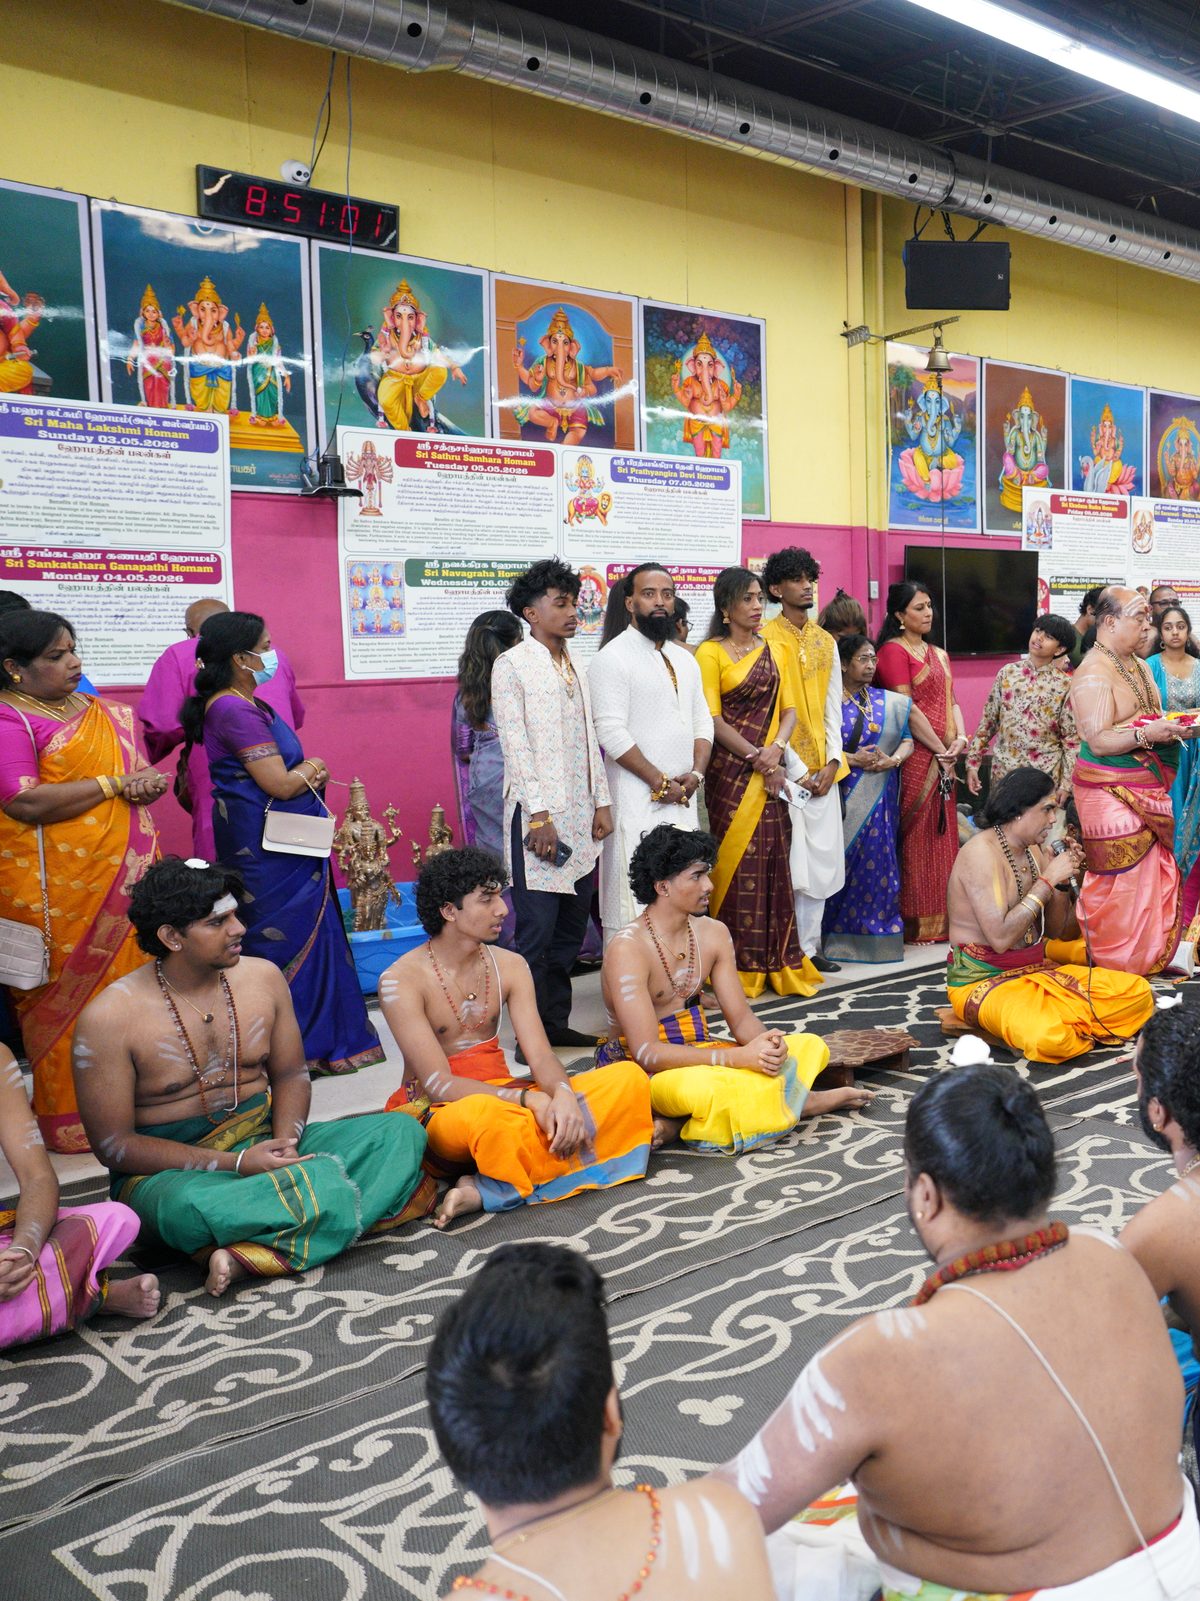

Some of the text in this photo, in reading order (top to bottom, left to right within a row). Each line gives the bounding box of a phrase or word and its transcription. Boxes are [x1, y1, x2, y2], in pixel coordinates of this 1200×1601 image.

[24, 416, 190, 440] Sri Maha Lakshmi Homam
[38, 430, 180, 449] Sunday 03.05.2026
[416, 450, 536, 466] Sri Sathru Samhara Homam
[425, 461, 528, 474] Tuesday 05.05.2026
[617, 466, 628, 474] Sri
[630, 468, 678, 478] Prathyangira
[697, 473, 724, 481] Homam
[627, 476, 715, 488] Thursday 07.05.2026
[5, 558, 214, 573] Sri Sankatahara Ganapathi Homam
[42, 572, 184, 583] Monday 04.05.2026
[424, 569, 439, 577] Sri
[441, 570, 496, 579] Navagraha
[420, 578, 479, 588] Wednesday
